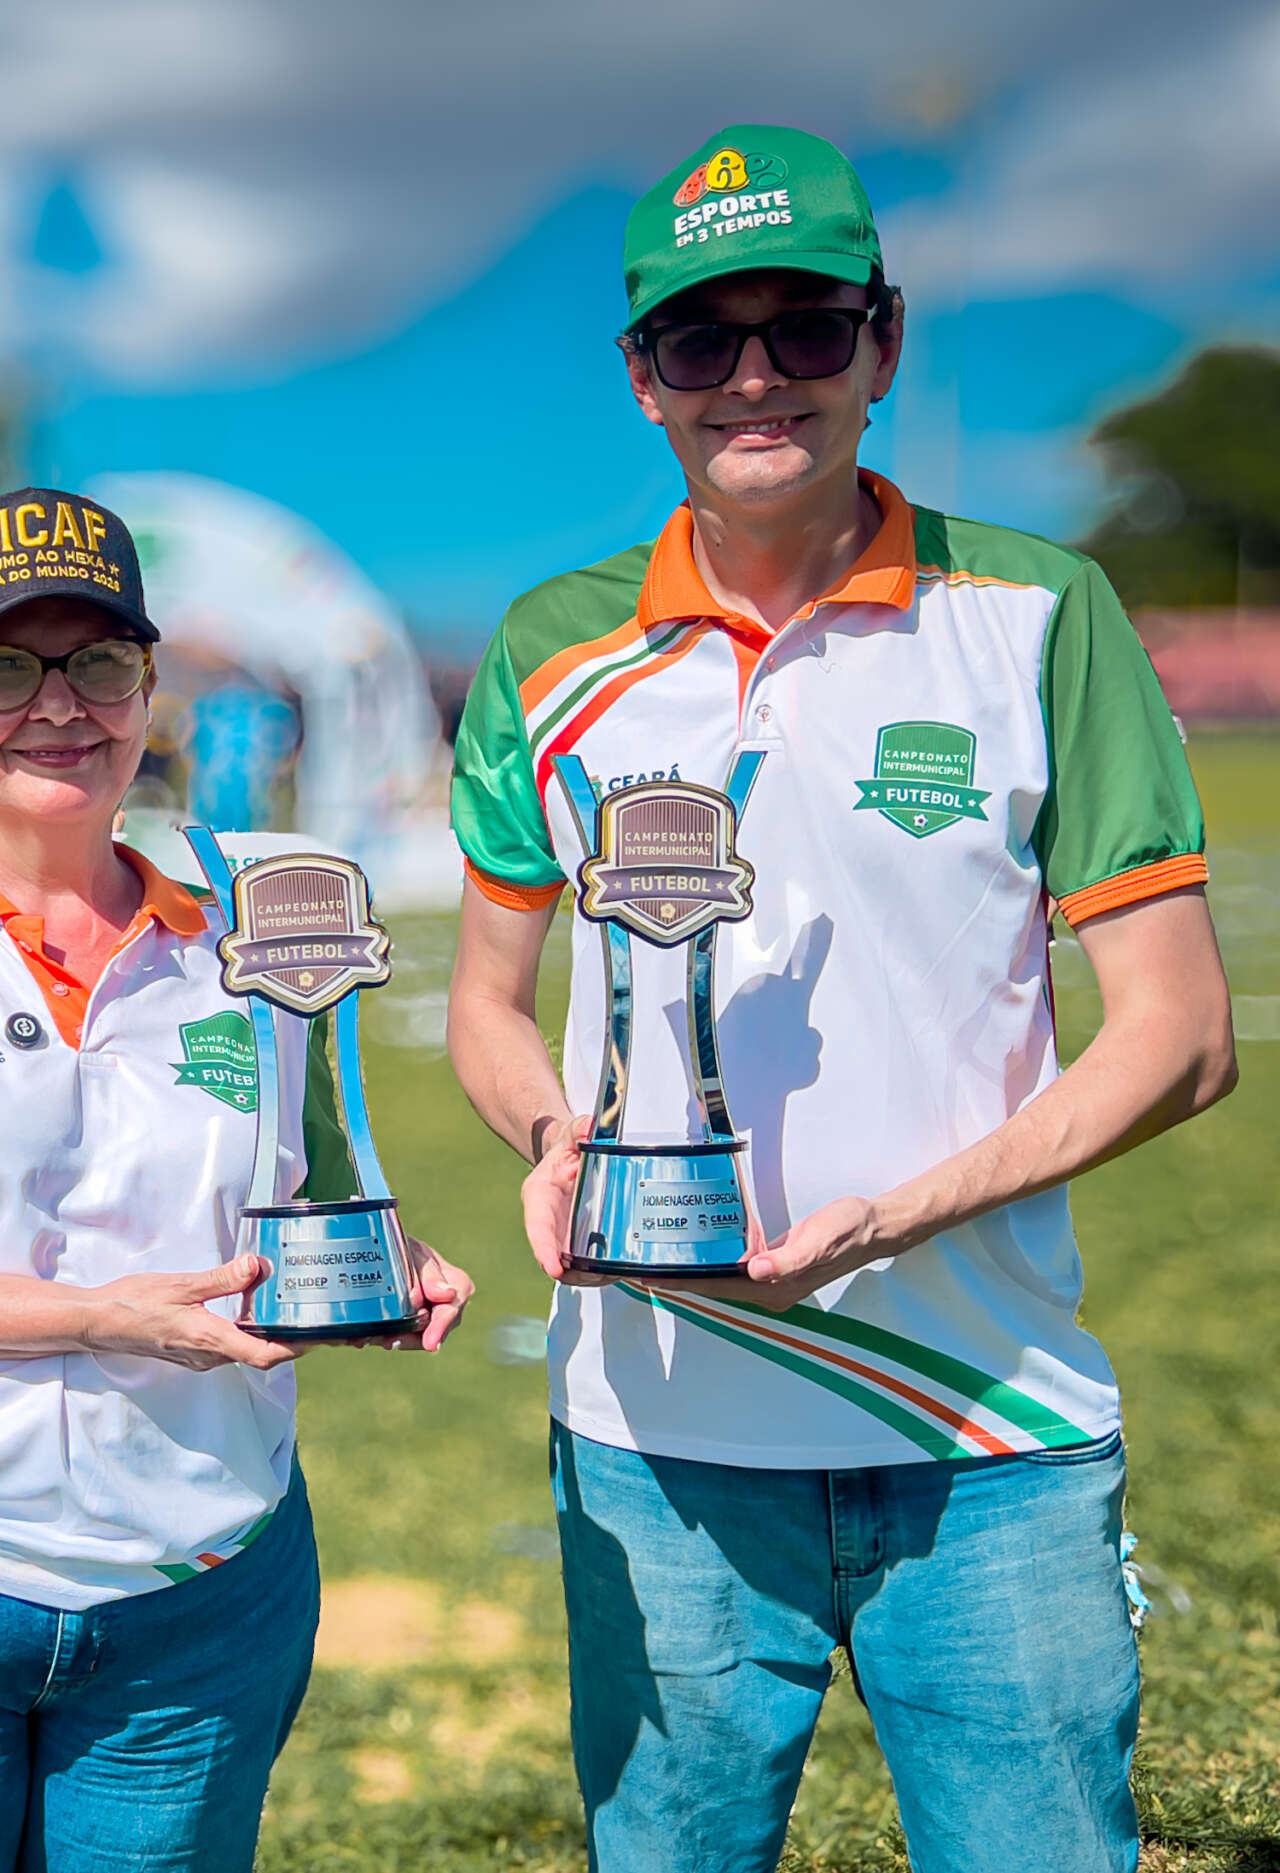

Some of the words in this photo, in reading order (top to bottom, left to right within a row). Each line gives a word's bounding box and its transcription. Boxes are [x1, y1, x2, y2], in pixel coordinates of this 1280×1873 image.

[674, 189, 790, 235] ESPORTE
[676, 232, 694, 248] EM
[697, 228, 709, 244] 3
[712, 210, 792, 237] TEMPOS
[35, 550, 59, 563] AO
[65, 551, 106, 570] HEXA
[8, 569, 31, 583] DO
[36, 566, 89, 579] MUNDO
[884, 750, 968, 763] CAMPEONATO
[883, 761, 966, 776] INTERMUNICIPAL
[886, 788, 963, 808] FUTEBOL
[625, 832, 713, 842] CAMPEONATO
[624, 846, 711, 856] INTERMUNICIPAL
[631, 875, 711, 892] FUTEBOL
[257, 900, 344, 915] CAMPEONATO
[258, 913, 344, 929] INTERMUNICIPAL
[266, 944, 347, 963] FUTEBOL
[190, 1035, 256, 1053] CAMPEONAT
[192, 1045, 256, 1063] INTERMUNICIP
[202, 1069, 256, 1086] FUTEB
[642, 1194, 703, 1207] HOMENAGEM
[704, 1192, 740, 1205] ESPECIAL
[657, 1218, 688, 1227] LIDEP
[285, 1253, 343, 1266] HOMENAGEM
[344, 1251, 384, 1264] ESPECIAL
[297, 1277, 328, 1287] LIDEP
[351, 1270, 383, 1281] CEARÁ
